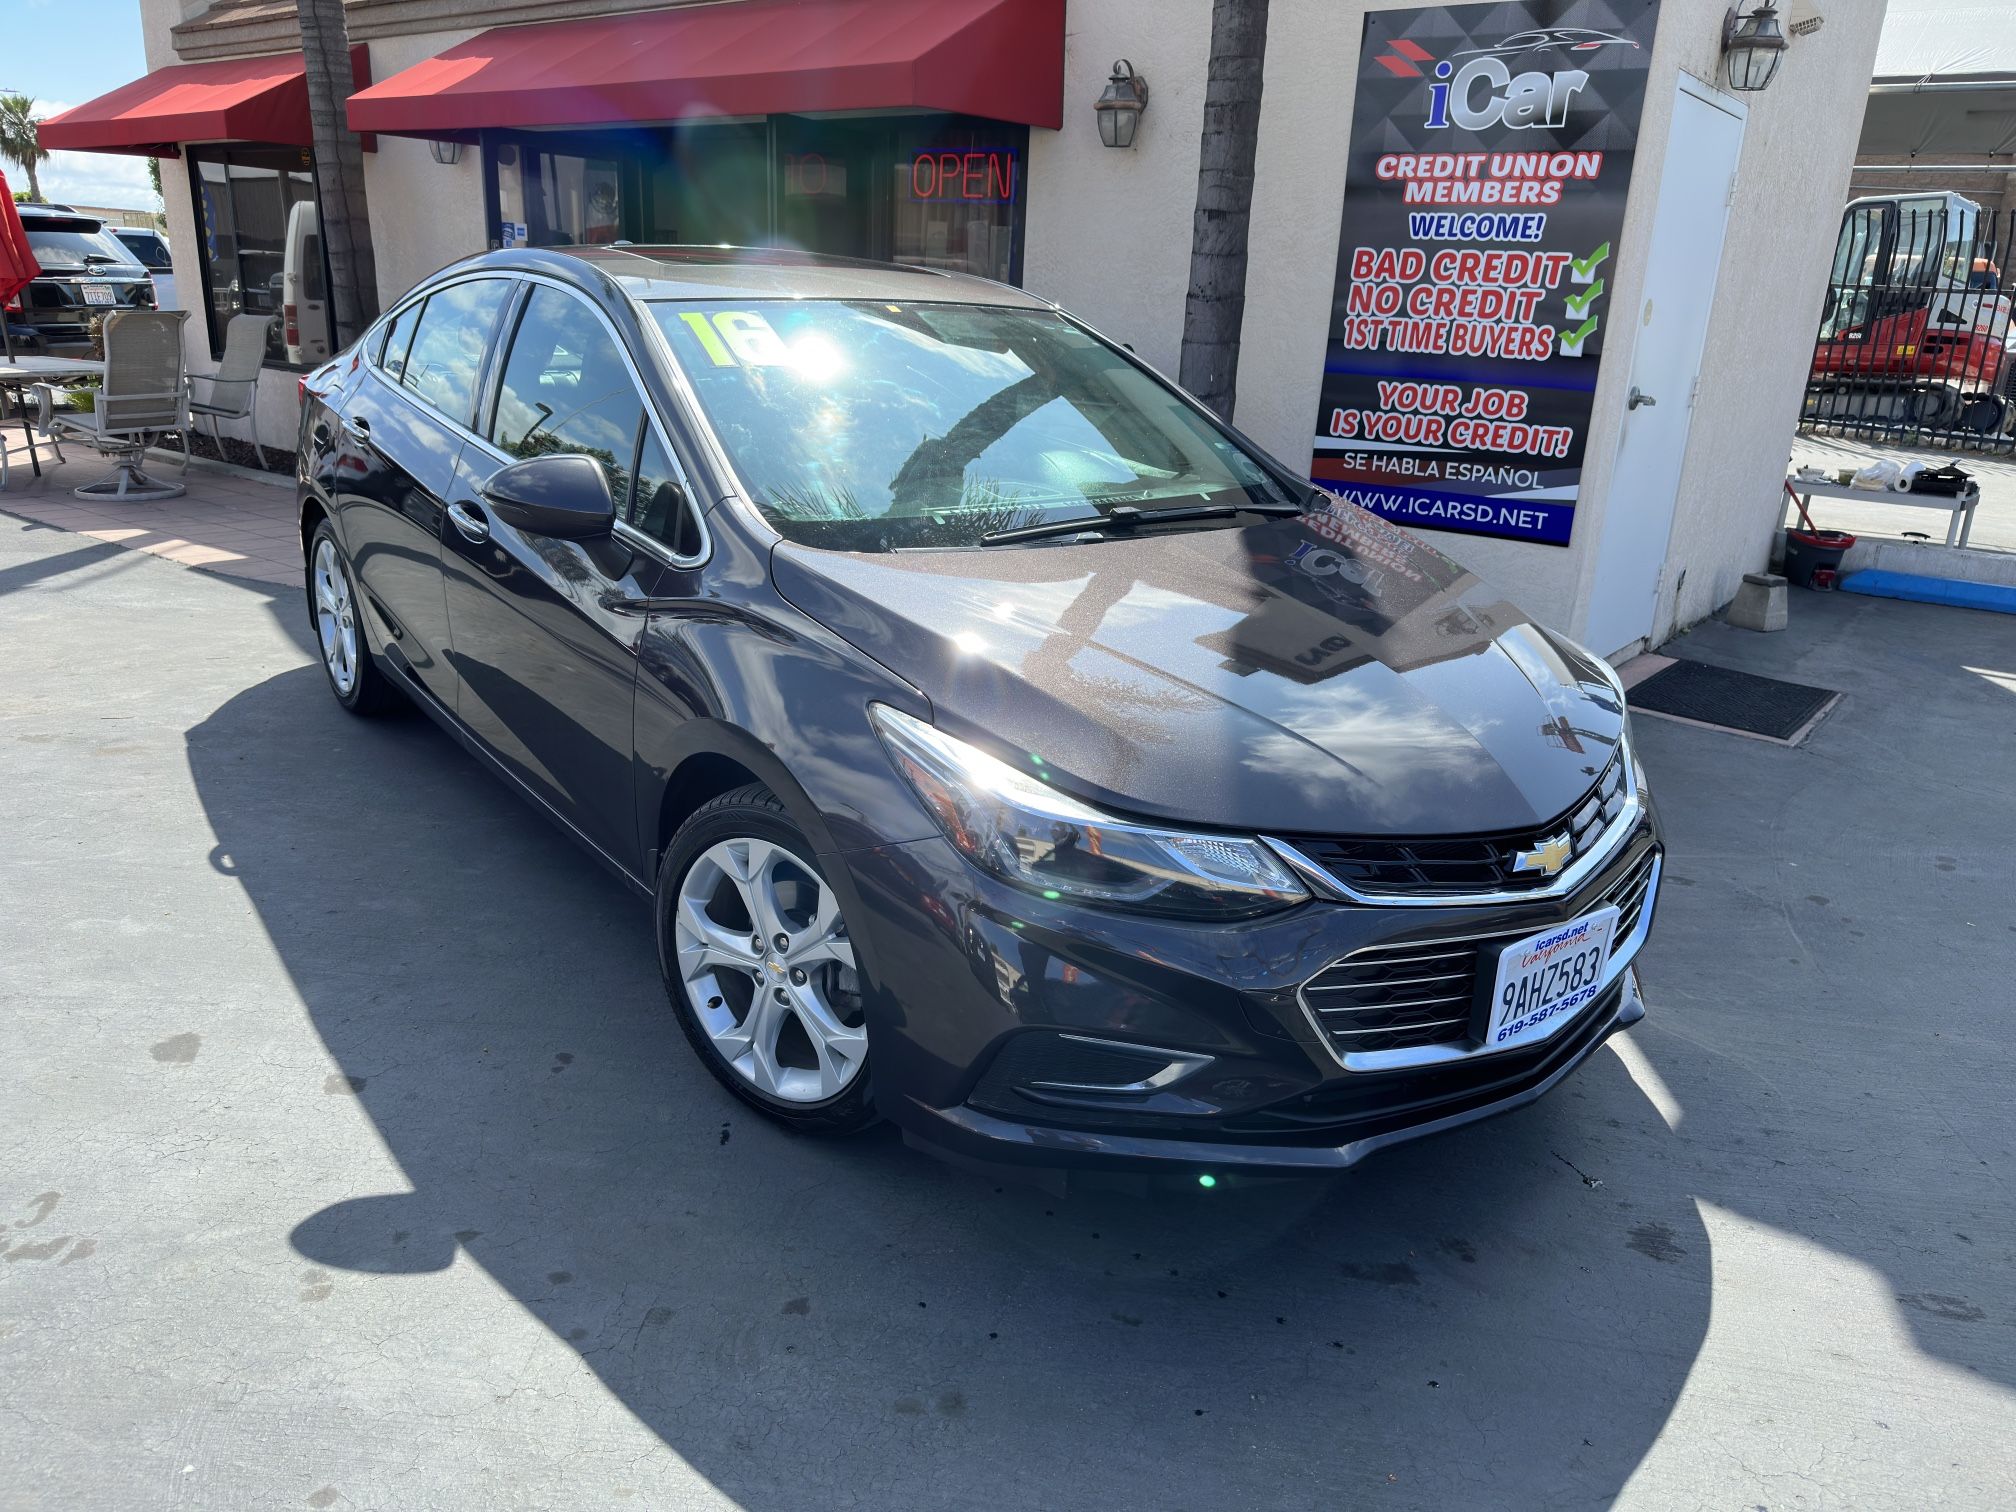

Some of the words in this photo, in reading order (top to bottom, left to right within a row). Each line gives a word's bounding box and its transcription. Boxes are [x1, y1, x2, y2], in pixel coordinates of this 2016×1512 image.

[1424, 57, 1590, 130] iCar
[913, 153, 1012, 198] OPEN
[1376, 153, 1487, 180] CREDIT
[1489, 152, 1602, 179] UNION
[1404, 179, 1561, 205] MEMBERS
[1409, 213, 1547, 242] WELCOME!
[1351, 249, 1425, 283] BAD
[1431, 250, 1572, 288] CREDIT
[1347, 282, 1402, 316] NO
[1407, 286, 1546, 322] CREDIT
[1344, 317, 1388, 350] 1ST
[1386, 319, 1446, 354] TIME
[1451, 323, 1555, 361] BUYERS
[1378, 381, 1462, 415] YOUR
[1461, 388, 1528, 421] JOB
[1330, 409, 1359, 437] IS
[1362, 411, 1445, 445] YOUR
[1448, 421, 1573, 458] CREDIT!
[1343, 452, 1368, 470] SE
[1371, 455, 1440, 478] HABLA
[1445, 464, 1544, 489] ESPAÑOL
[1535, 921, 1590, 951] icarsd.net
[1500, 946, 1600, 1026] 9AHZ583
[1497, 984, 1597, 1042] 619-587-5678
